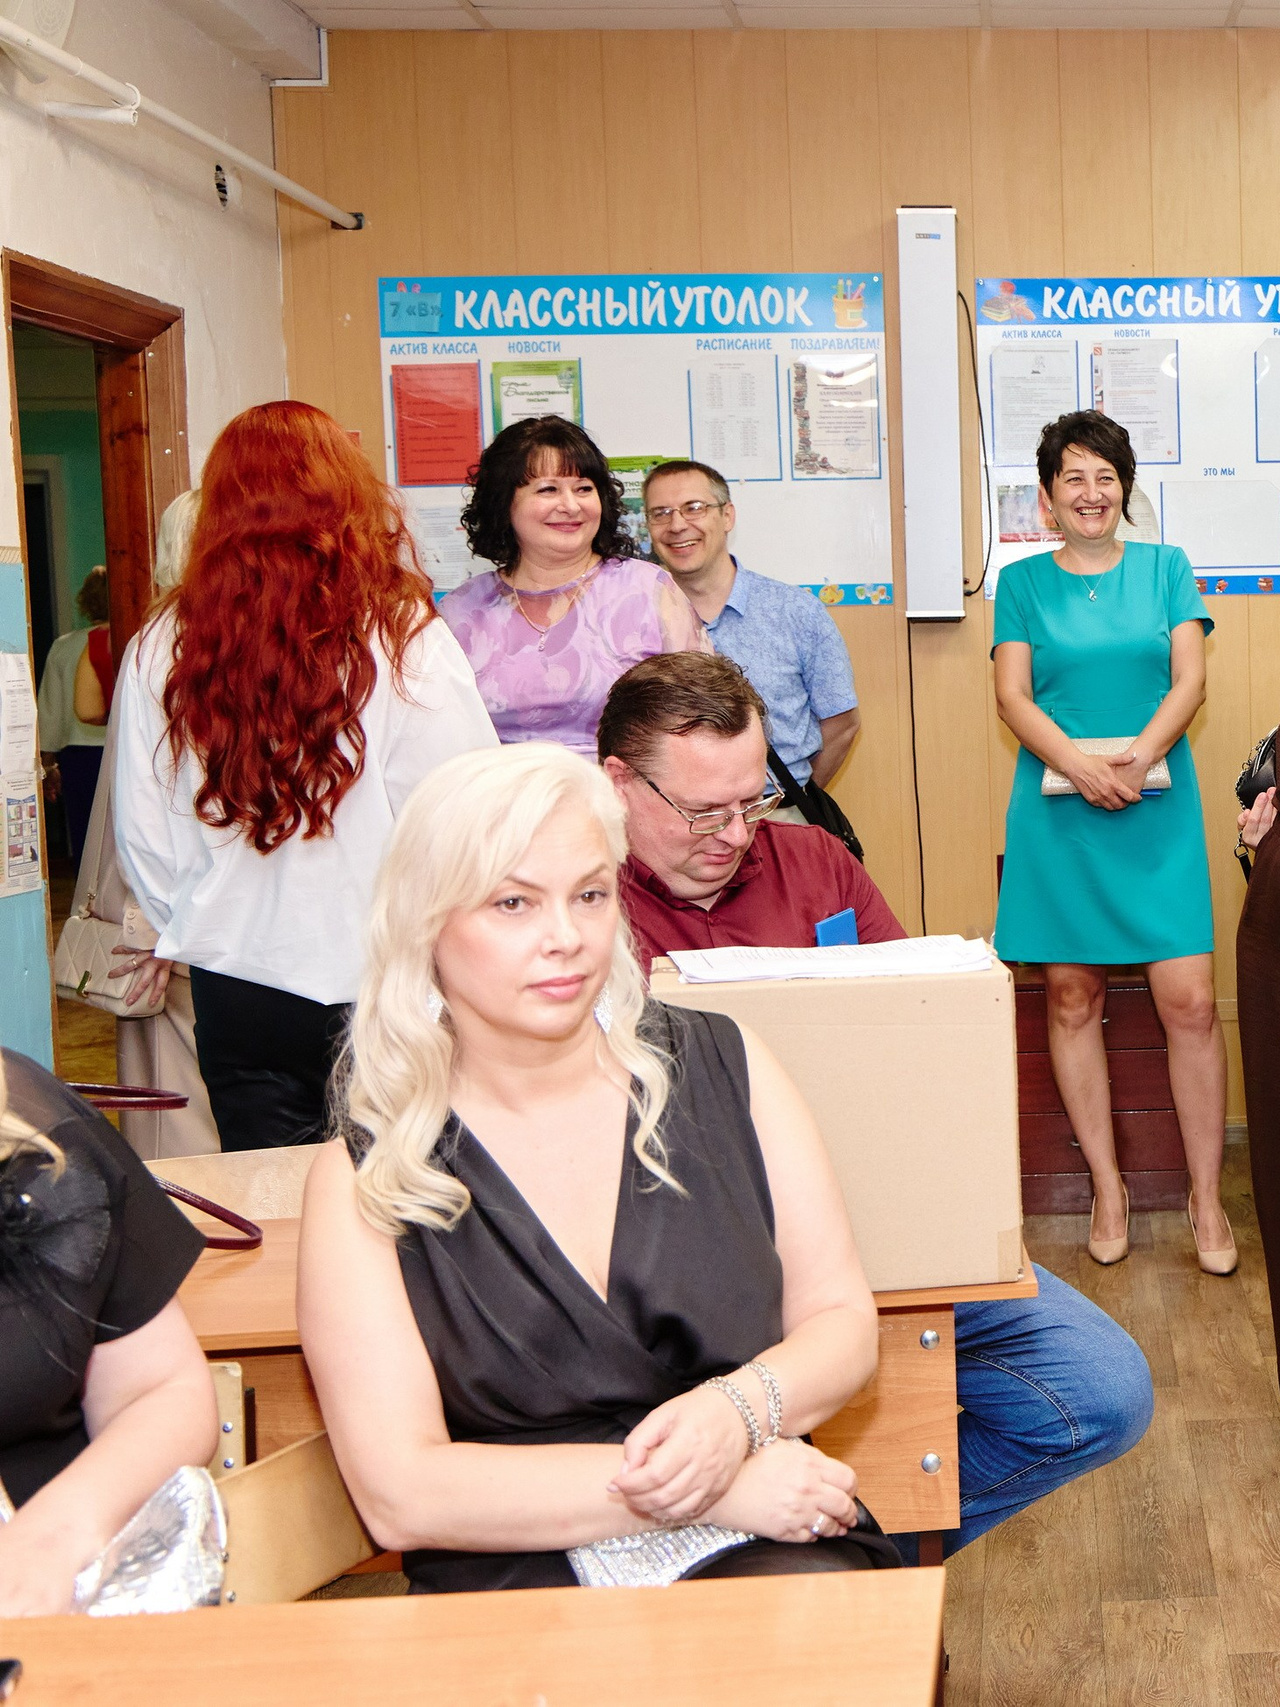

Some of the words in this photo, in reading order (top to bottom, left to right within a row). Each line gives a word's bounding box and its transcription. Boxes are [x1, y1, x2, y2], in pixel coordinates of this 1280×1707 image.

[454, 280, 668, 330] КЛАССНЫЙ
[669, 284, 814, 328] УГОЛОК
[1042, 279, 1242, 320] КЛАССНЫЙ
[389, 301, 400, 317] 7
[1002, 329, 1028, 339] АКТИВ
[1031, 329, 1062, 339] КЛАССА
[1114, 328, 1150, 338] НОВОСТИ
[389, 342, 428, 356] АКТИВ
[432, 341, 478, 355] КЛАССА
[508, 340, 561, 354] НОВОСТИ
[696, 338, 772, 351] РАСПИСАНИЕ
[790, 337, 880, 350] ПОЗДРАВЛЯЕМ!
[1203, 467, 1218, 476] ЭТО
[1220, 467, 1235, 476] МЫ
